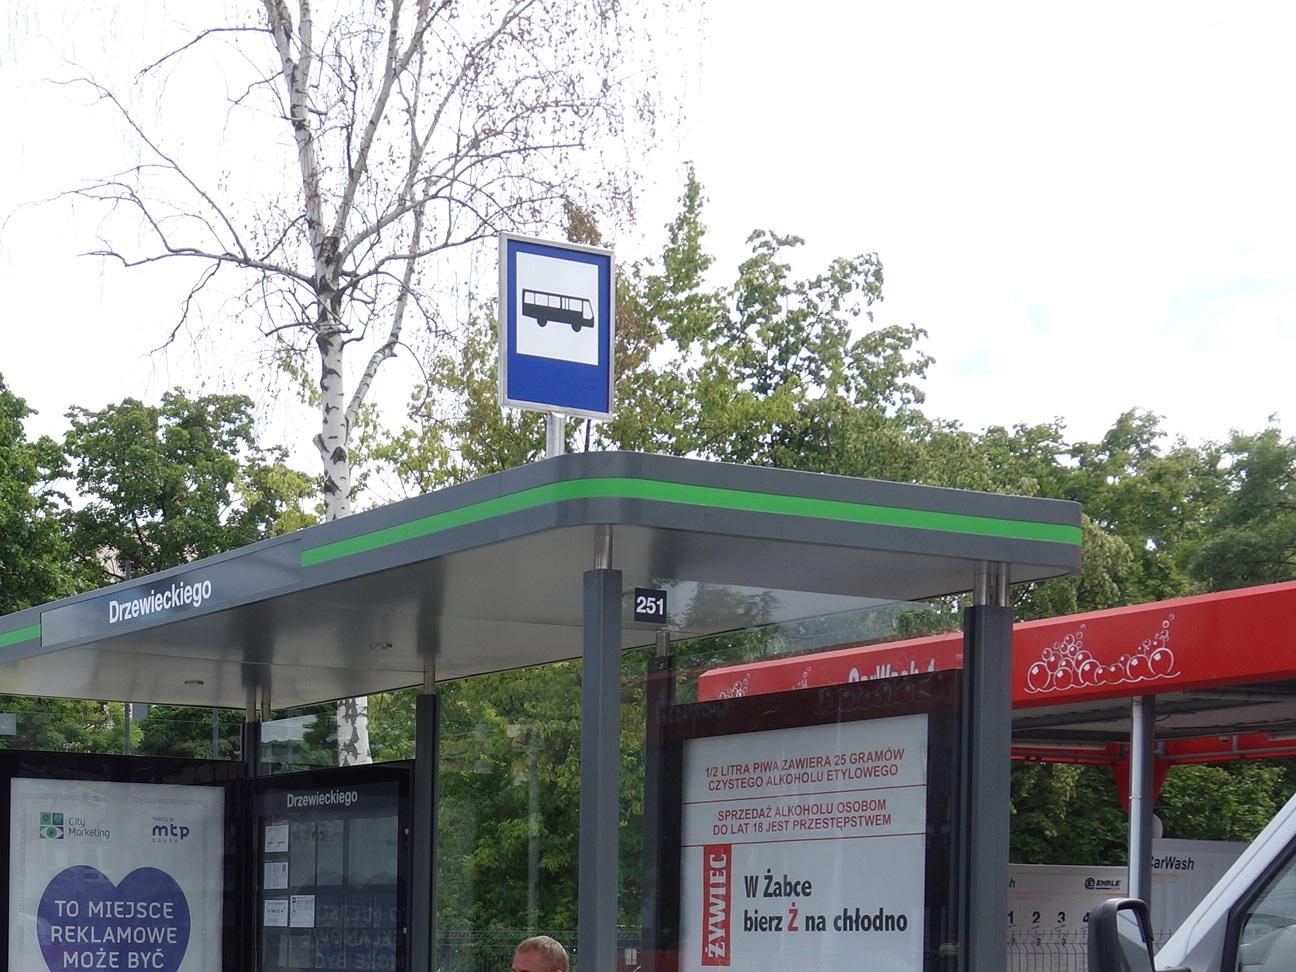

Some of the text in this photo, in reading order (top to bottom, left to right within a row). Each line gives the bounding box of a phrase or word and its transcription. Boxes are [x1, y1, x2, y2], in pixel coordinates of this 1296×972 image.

[109, 580, 212, 624] Drzewieckiego
[636, 596, 664, 615] 251
[721, 763, 751, 777] LITRA
[754, 760, 780, 774] PIWA
[782, 755, 831, 771] ZAWIERA
[834, 754, 847, 767] 25
[849, 747, 905, 765] GRAMÓW
[708, 764, 899, 792] CZYSTEGO ALKOHOLU ETYLOWEGO
[287, 789, 358, 808] Drzewieckiego
[718, 799, 887, 822] SPRZEDAŻ ALKOHOLU OSOBOM
[68, 817, 86, 827] City
[152, 823, 190, 840] mtp
[713, 814, 892, 836] DO LAT 18 JEST PRZESTĘPSTWEM
[68, 827, 110, 840] Marketing
[1151, 855, 1195, 871] arWash
[744, 868, 812, 898] W Żabce
[54, 900, 174, 919] TO MIEJSCE
[705, 853, 727, 959] ŻYWIEC
[743, 902, 908, 933] bierz Ż na chłodno
[1032, 911, 1041, 924] 2
[1057, 911, 1066, 924] 3
[51, 925, 177, 944] REKLAMOWE
[63, 948, 120, 969] MOŻE
